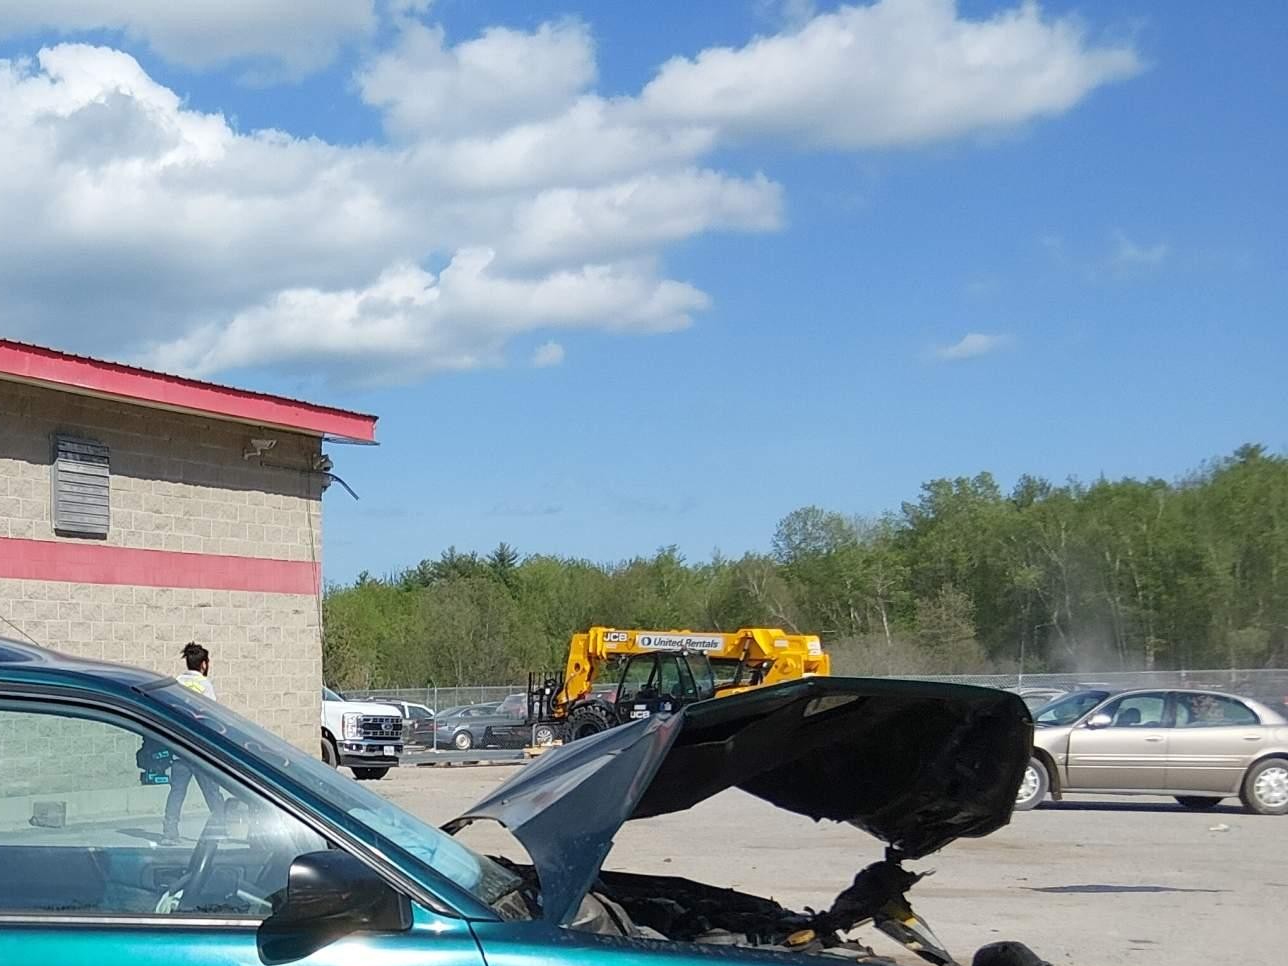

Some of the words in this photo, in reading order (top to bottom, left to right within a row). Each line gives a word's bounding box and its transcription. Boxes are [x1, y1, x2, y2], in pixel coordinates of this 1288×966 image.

[603, 632, 628, 642] JCB
[653, 637, 683, 648] United
[684, 638, 719, 649] Rentals
[629, 710, 651, 719] JCB
